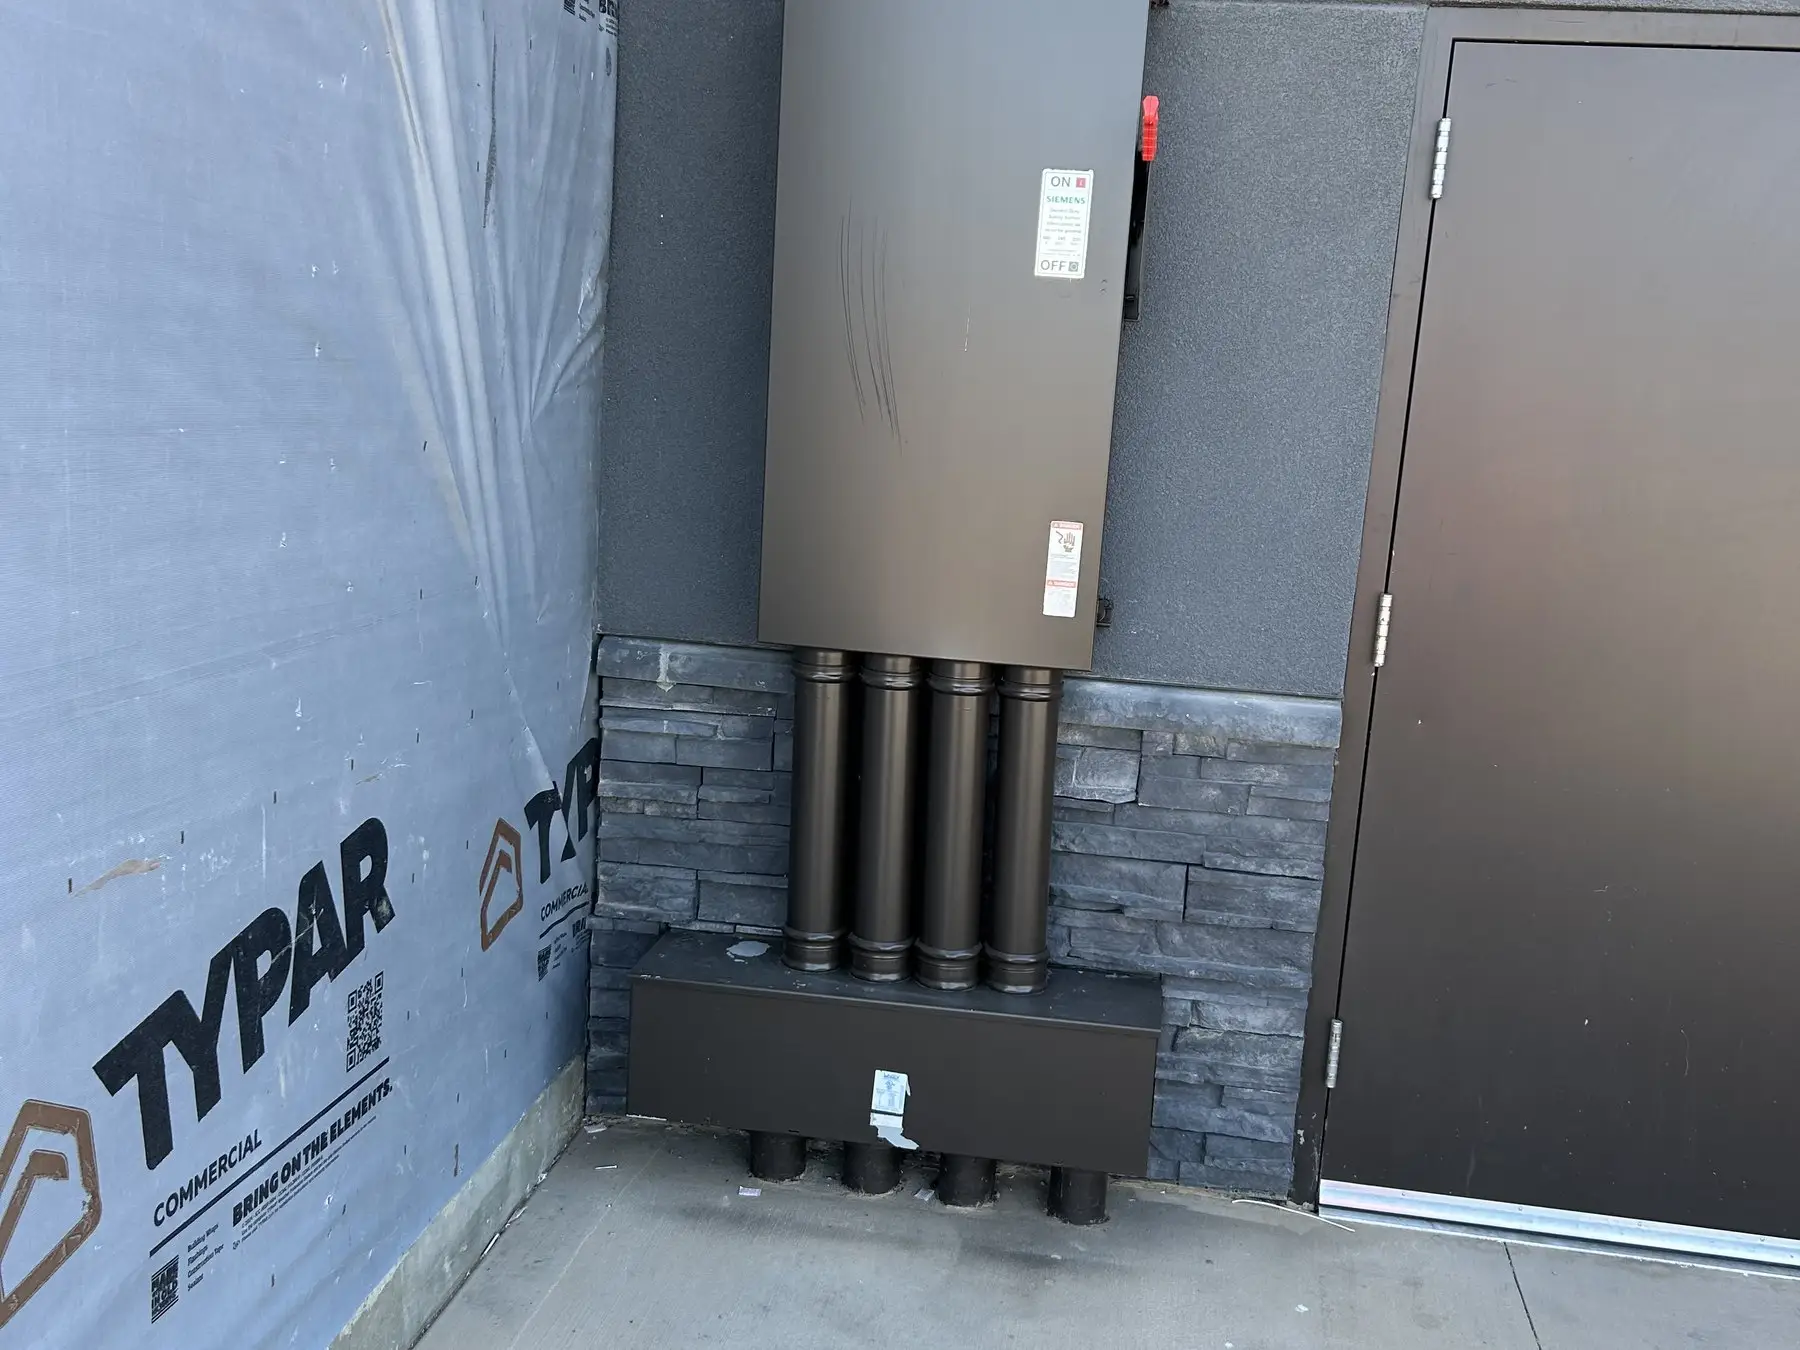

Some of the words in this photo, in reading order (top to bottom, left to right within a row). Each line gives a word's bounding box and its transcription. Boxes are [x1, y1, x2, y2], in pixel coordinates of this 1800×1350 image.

[1046, 195, 1086, 205] SIEMENS
[1050, 175, 1071, 188] ON
[1040, 259, 1067, 271] OFF
[93, 817, 395, 1170] TYPAR
[153, 1128, 262, 1227] COMMERCIAL
[232, 1170, 279, 1228] BRING
[280, 1151, 302, 1184] ON
[302, 1130, 329, 1166] THE
[329, 1077, 393, 1144] ELEMENTS.
